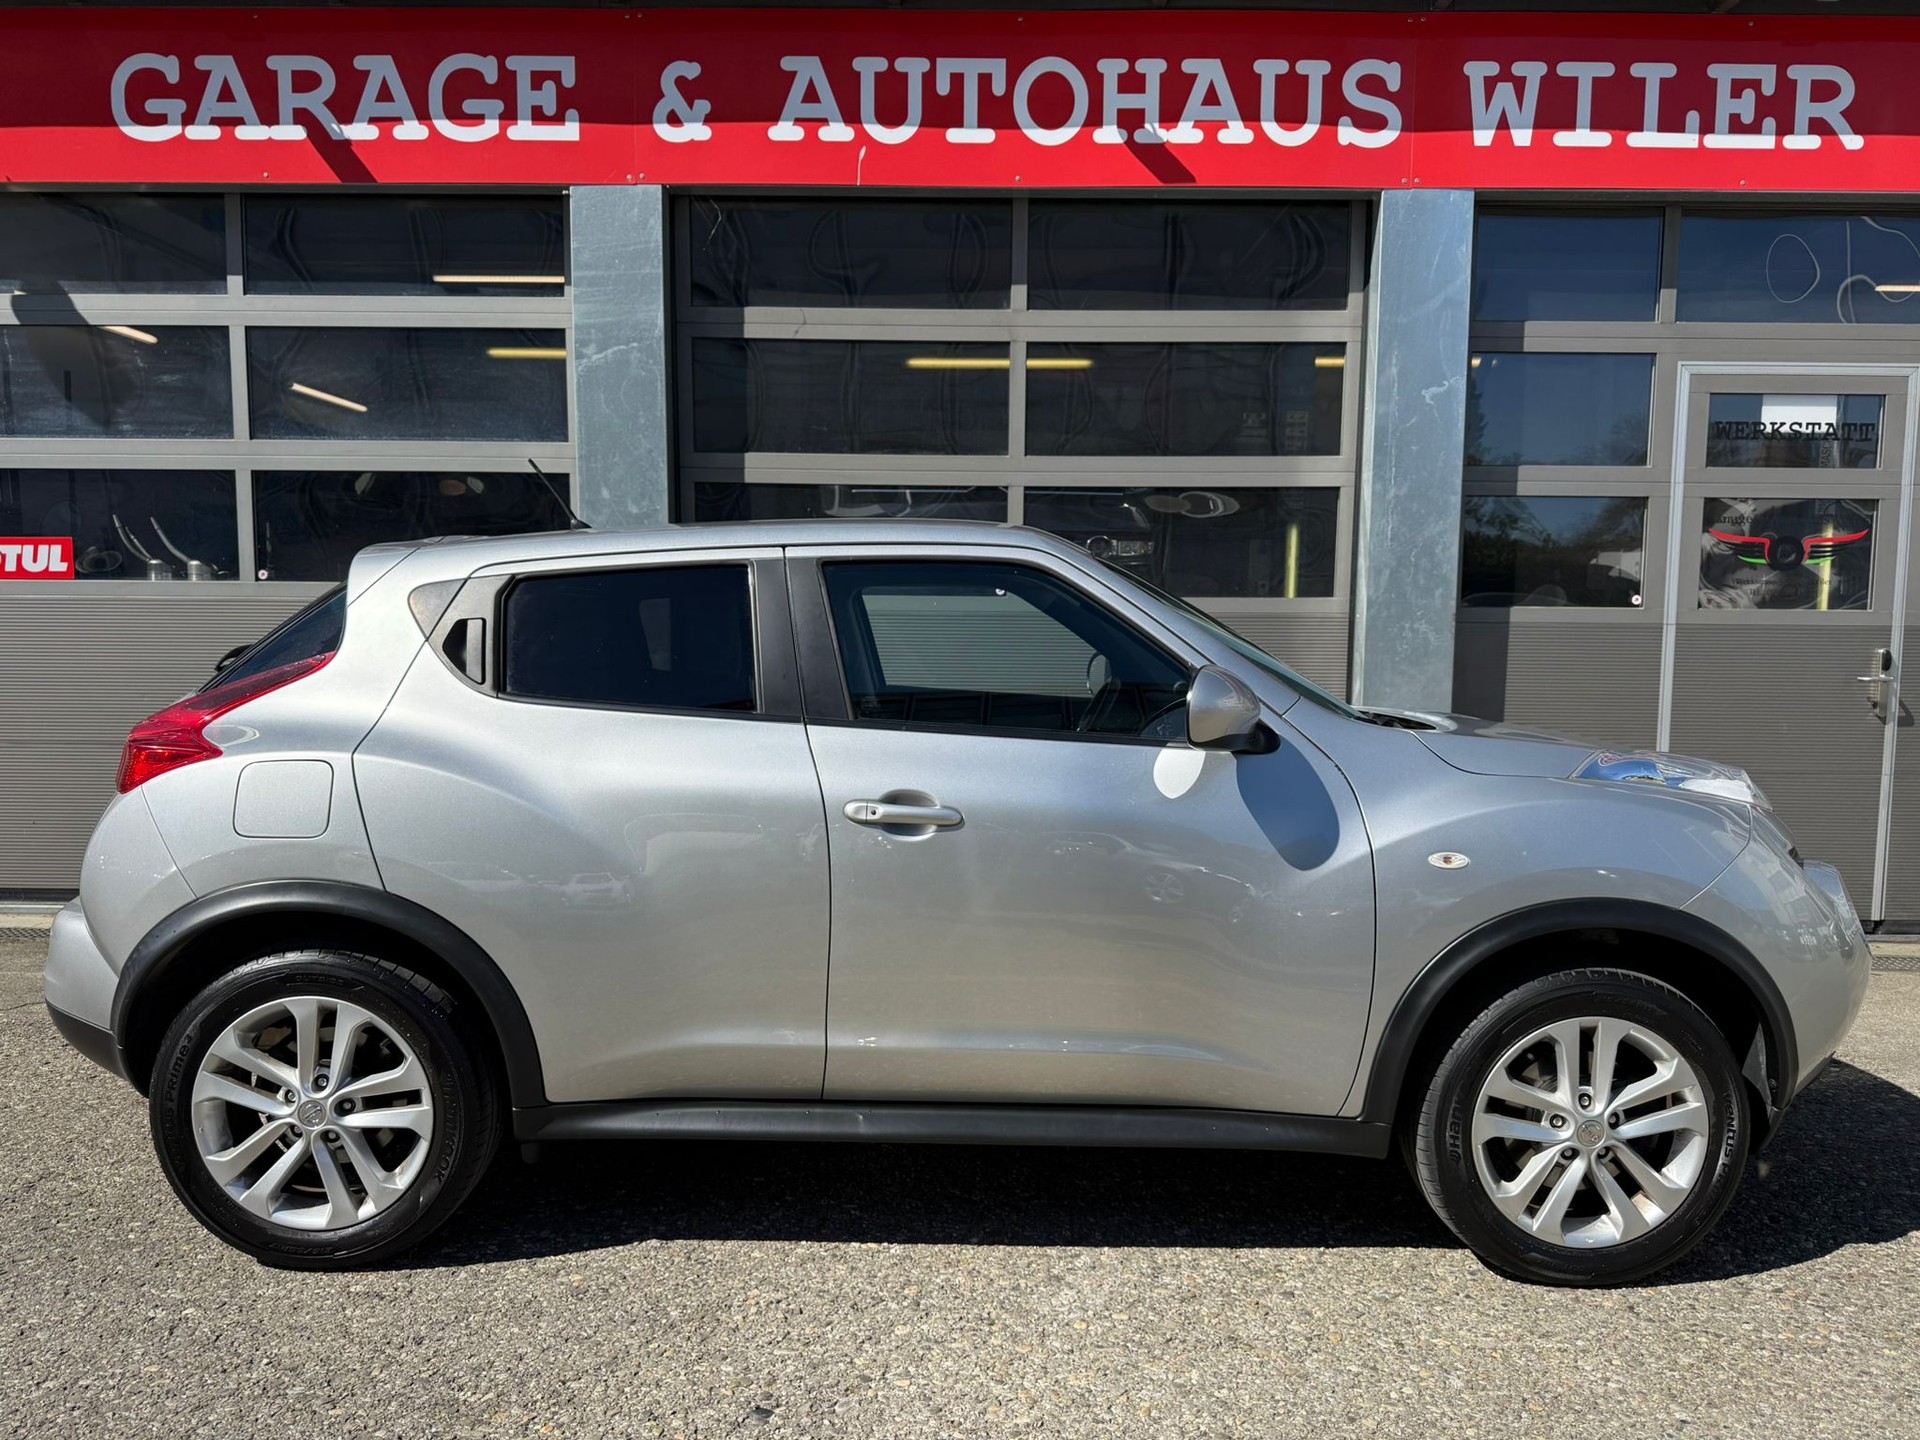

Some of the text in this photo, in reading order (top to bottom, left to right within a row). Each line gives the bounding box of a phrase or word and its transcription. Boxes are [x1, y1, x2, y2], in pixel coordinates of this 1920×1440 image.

[110, 52, 1865, 151] GARAGE & AUTOHAUS WILER
[1713, 421, 1875, 442] WERKSTATT
[0, 544, 69, 573] TUL
